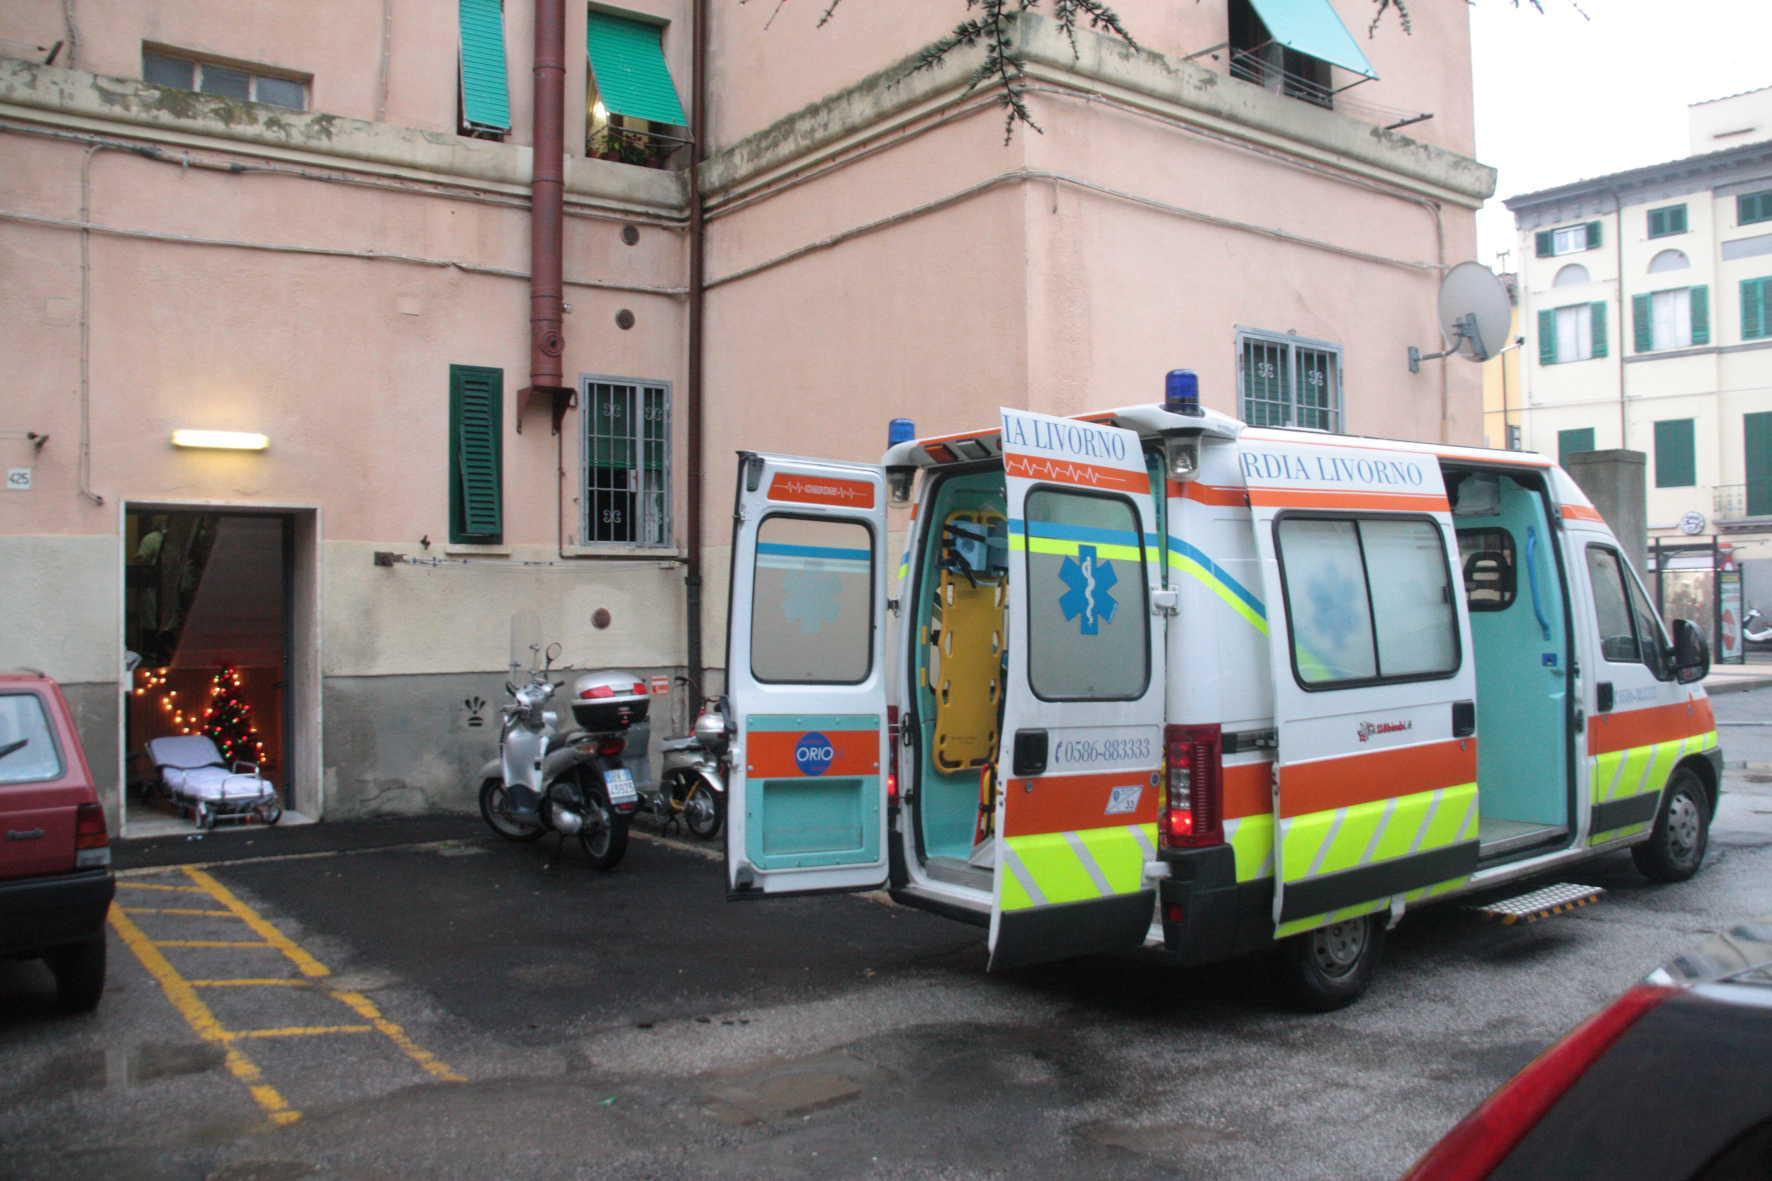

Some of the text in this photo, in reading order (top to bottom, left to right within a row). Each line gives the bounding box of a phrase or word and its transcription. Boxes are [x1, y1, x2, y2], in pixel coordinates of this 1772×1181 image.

[1033, 419, 1126, 461] LIVORNO
[1316, 456, 1423, 487] LIVORNO
[1064, 738, 1150, 762] 0586-883333
